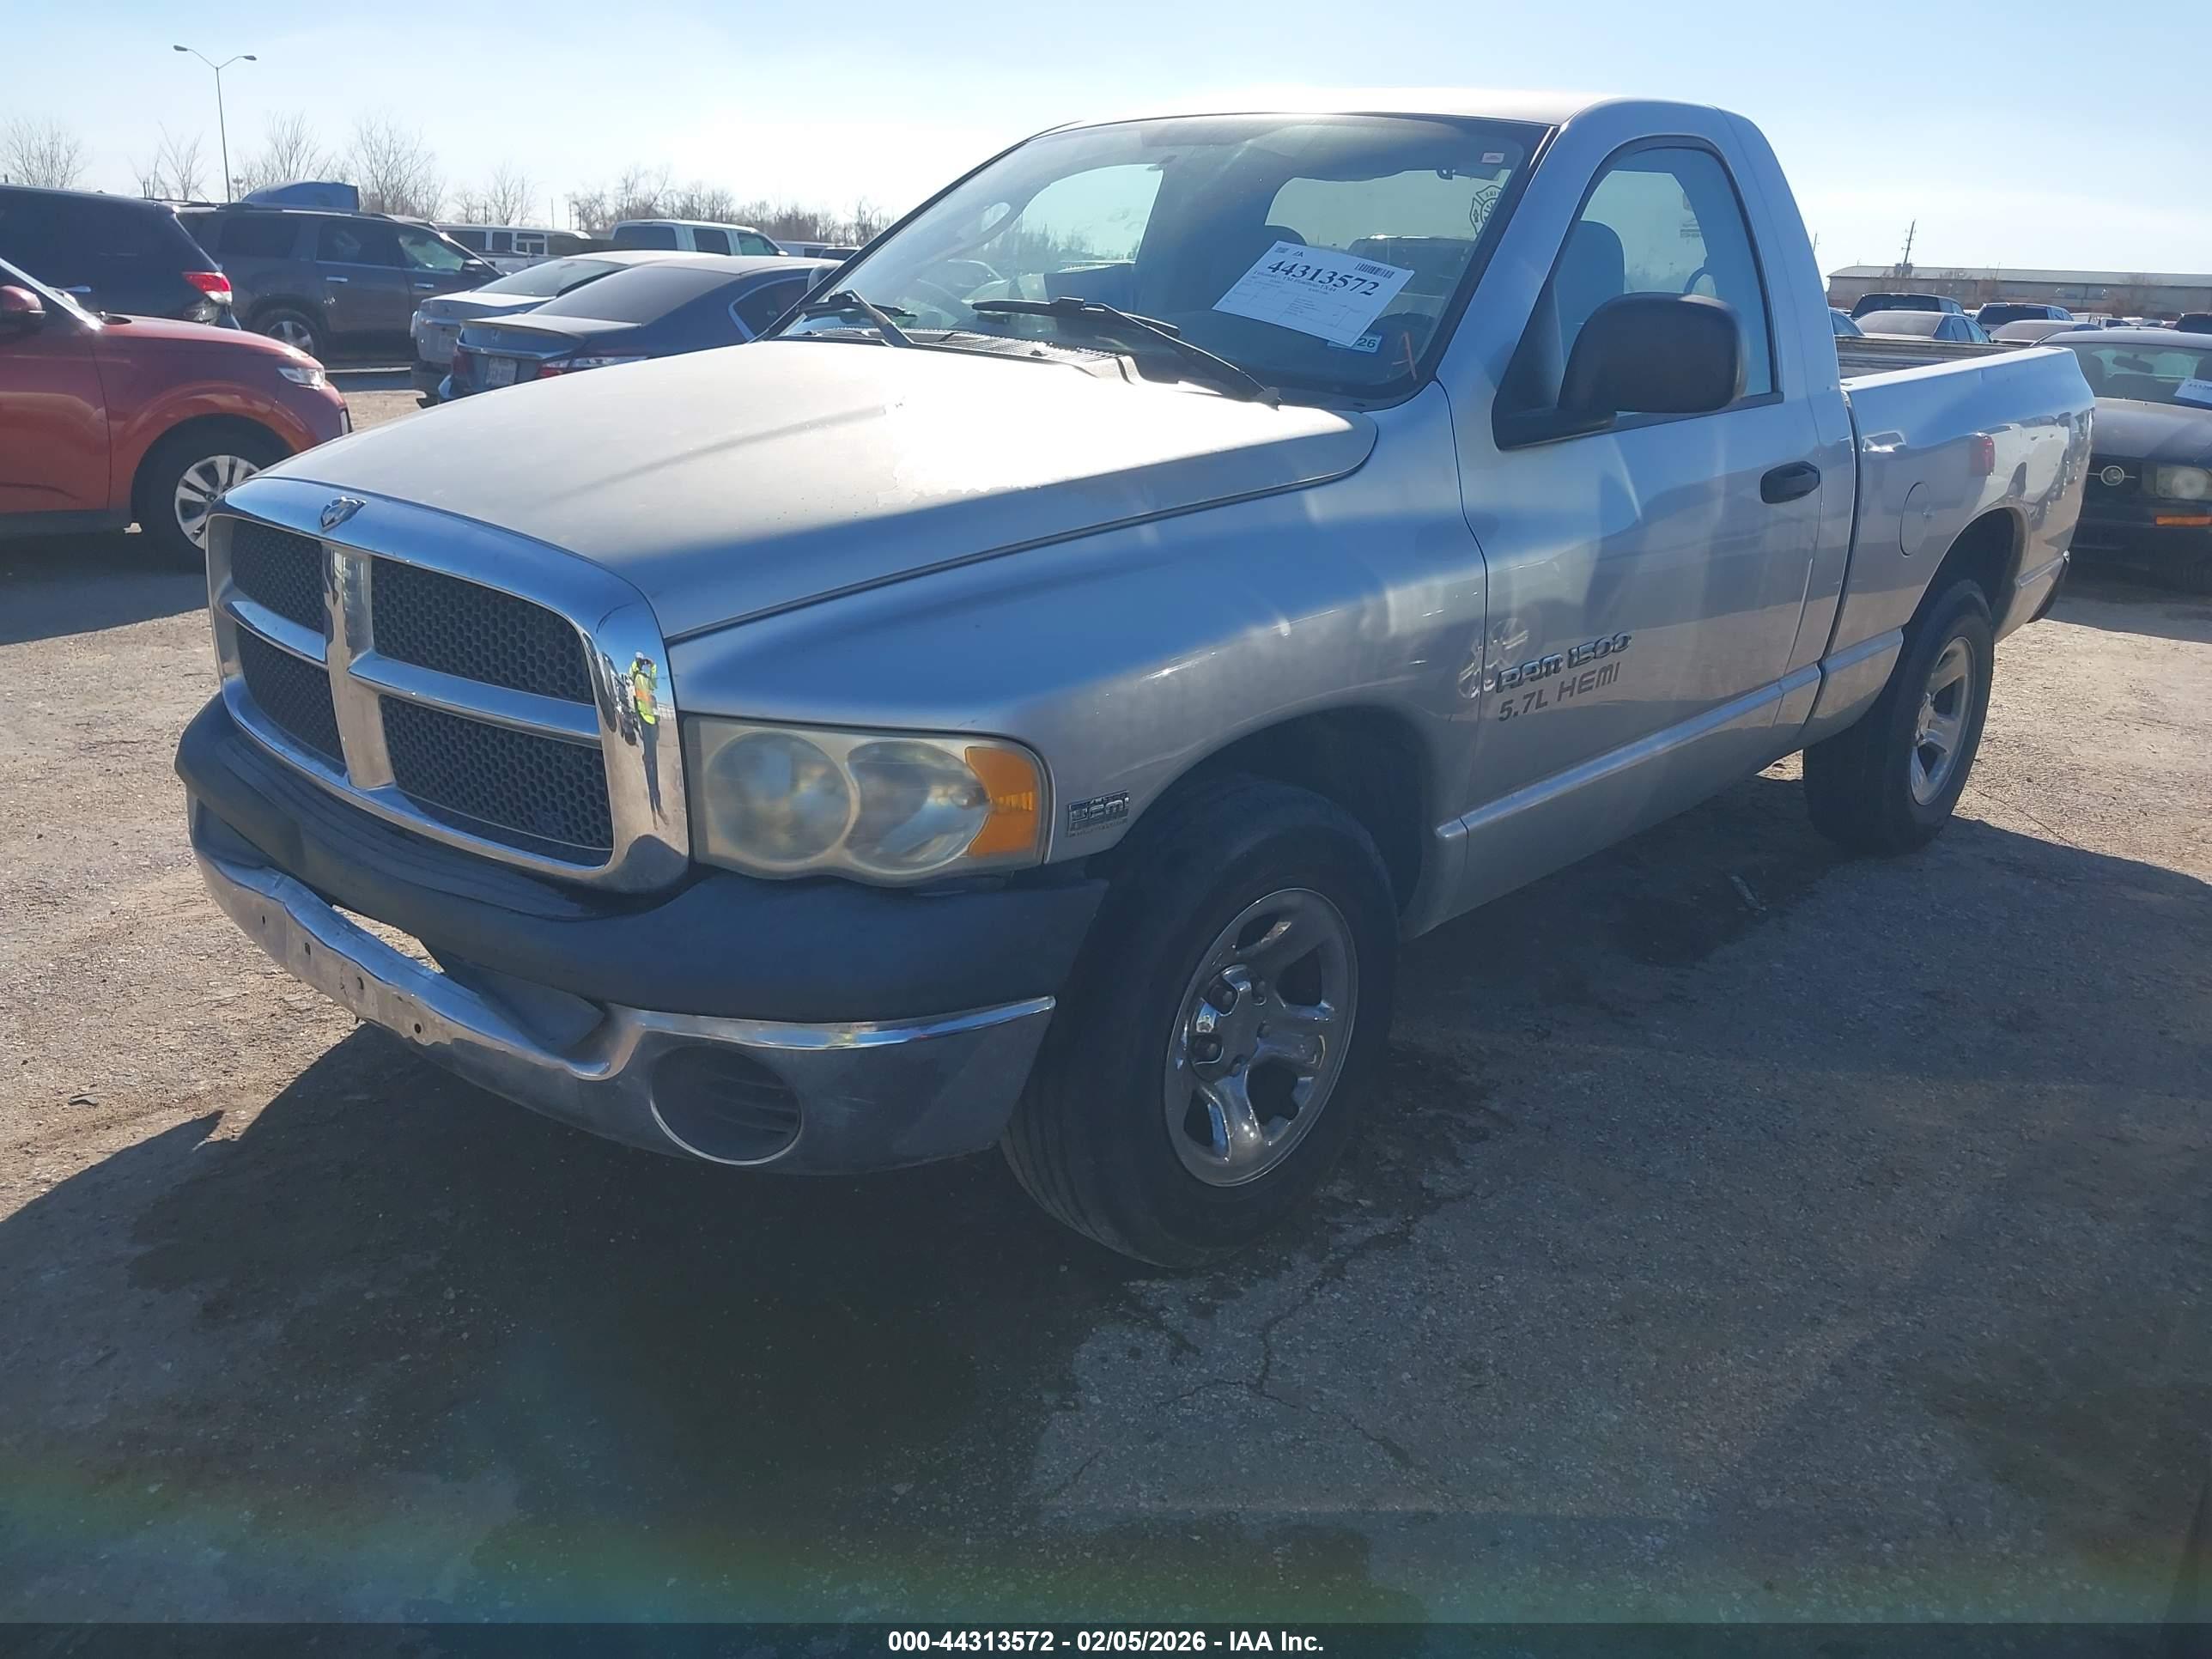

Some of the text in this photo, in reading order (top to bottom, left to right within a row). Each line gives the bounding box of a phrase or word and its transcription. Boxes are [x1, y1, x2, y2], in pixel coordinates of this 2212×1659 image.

[1267, 259, 1380, 296] 44313572
[1357, 337, 1377, 349] 26
[1567, 630, 1632, 670] 1500
[1498, 662, 1621, 722] 5.7L HEMI
